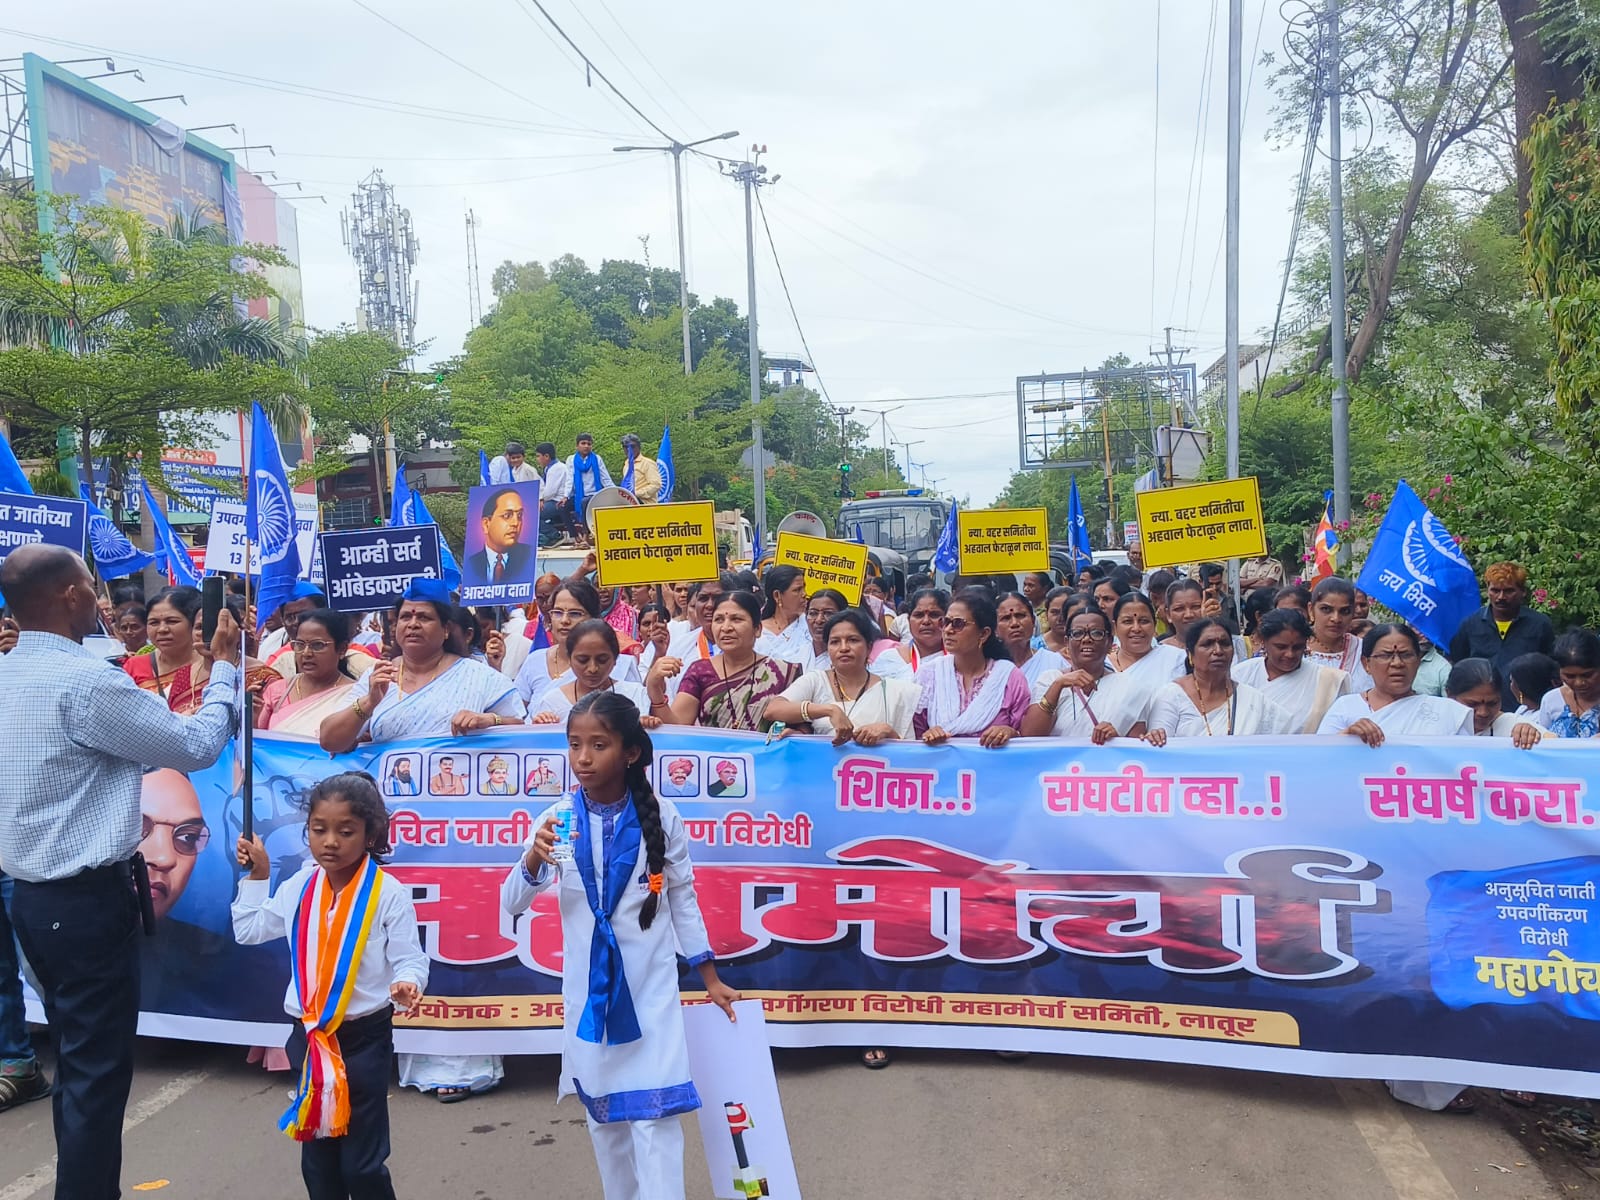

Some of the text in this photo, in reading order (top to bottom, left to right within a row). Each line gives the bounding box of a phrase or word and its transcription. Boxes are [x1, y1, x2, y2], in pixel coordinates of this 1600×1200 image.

[12, 504, 73, 528] जातीच्या
[1150, 510, 1173, 523] न्या.
[1198, 499, 1244, 517] समितीचा
[608, 528, 630, 541] न्या.
[656, 521, 702, 538] समितीचा
[1002, 524, 1037, 537] समितीचा
[1148, 527, 1184, 543] अहवाल
[1185, 523, 1225, 540] फेटाळून
[1227, 519, 1256, 533] लावा.
[340, 535, 422, 566] आम्ही सर्व
[604, 543, 713, 562] अहवाल फेटाळून लावा.
[964, 540, 1044, 556] अहवाल फेटाळून लावा.
[229, 552, 242, 565] 13
[821, 554, 856, 570] समितीचा
[807, 566, 837, 585] फेटाळून
[838, 574, 859, 586] लावा.
[463, 582, 531, 600] आरक्षण दाता
[1378, 568, 1438, 617] जय भिम
[1043, 765, 1174, 814] संघटीत
[1364, 766, 1477, 819] संघर्ष
[455, 811, 532, 844] जाती
[723, 811, 812, 846] विरोधी
[1485, 879, 1596, 904] अनुसूचित जाती
[1496, 905, 1588, 924] उपवर्गीकरण
[1520, 927, 1569, 947] विरोधी
[862, 994, 945, 1014] विरोधी
[949, 997, 1066, 1019] महामोर्चा
[1070, 1003, 1170, 1029] समिती,
[1176, 1011, 1257, 1037] लातूर
